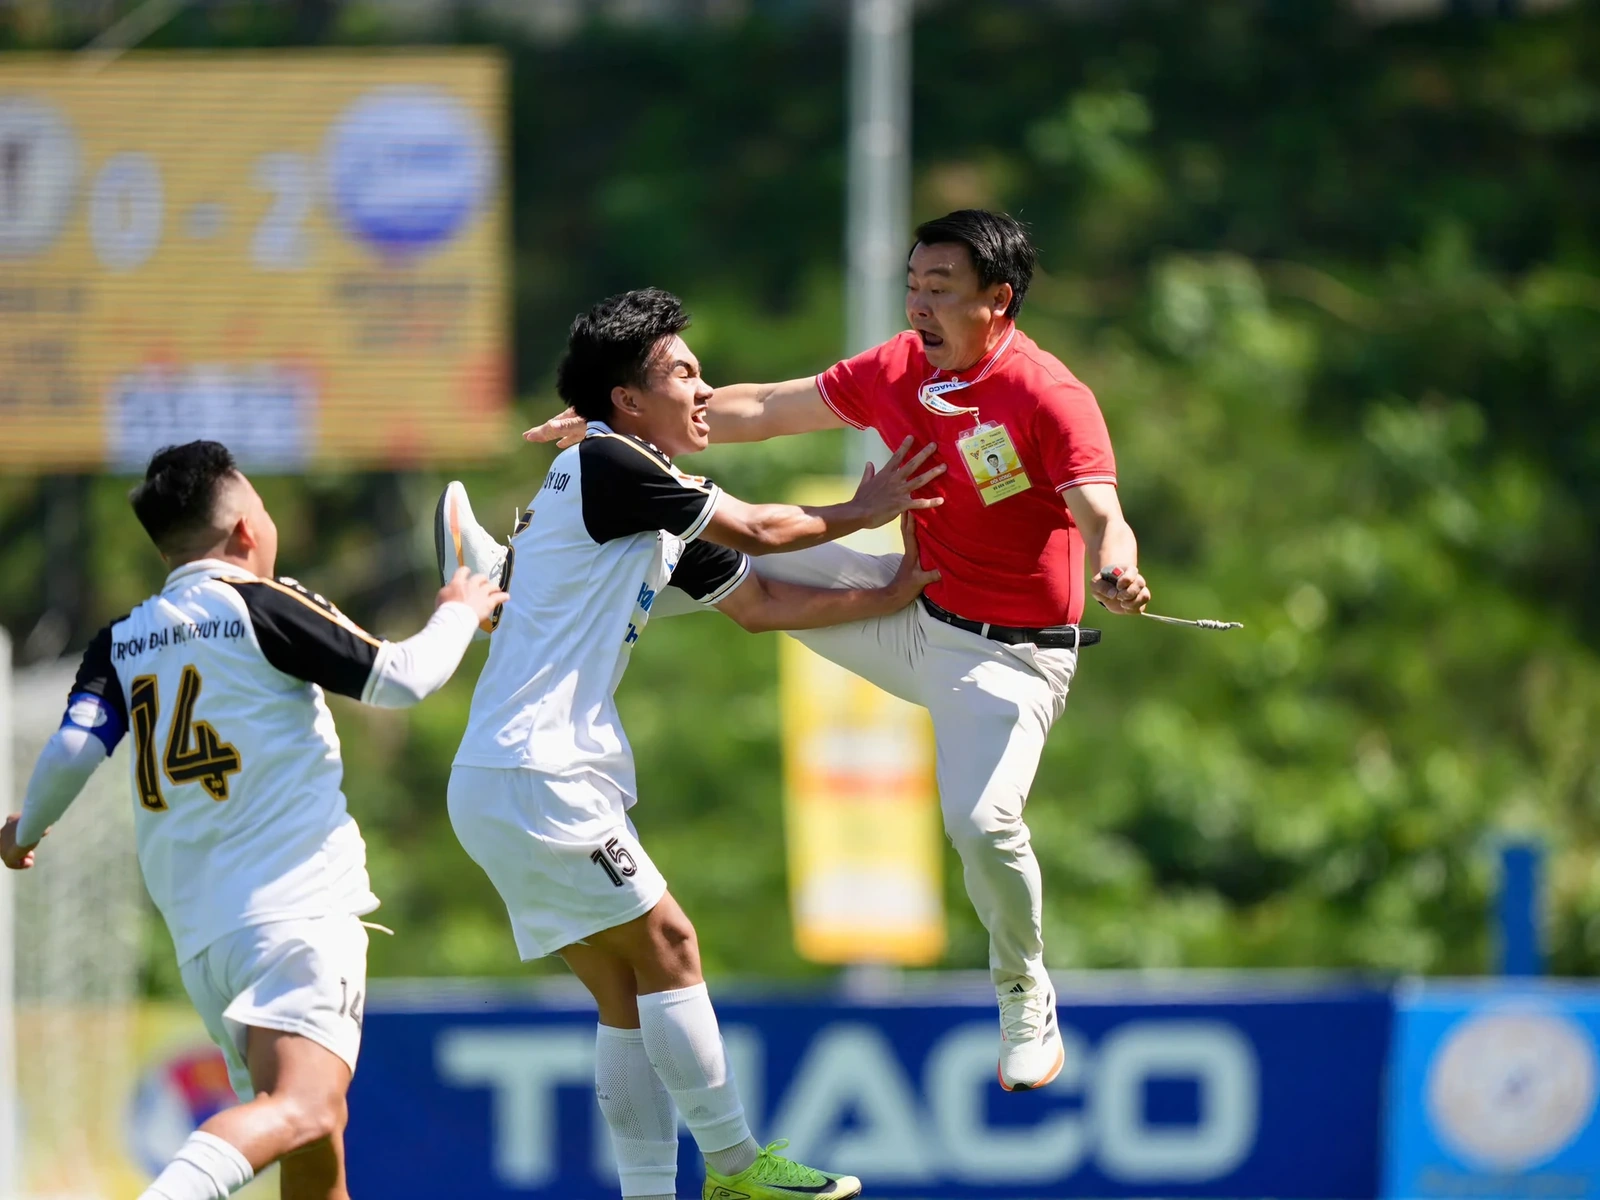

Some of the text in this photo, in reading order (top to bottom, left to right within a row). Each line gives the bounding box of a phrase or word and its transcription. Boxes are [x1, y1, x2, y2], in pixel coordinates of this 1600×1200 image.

[928, 383, 957, 393] THACO
[553, 472, 571, 495] LỢI
[224, 618, 246, 643] LỢI
[130, 663, 242, 812] 14
[590, 837, 638, 888] 15
